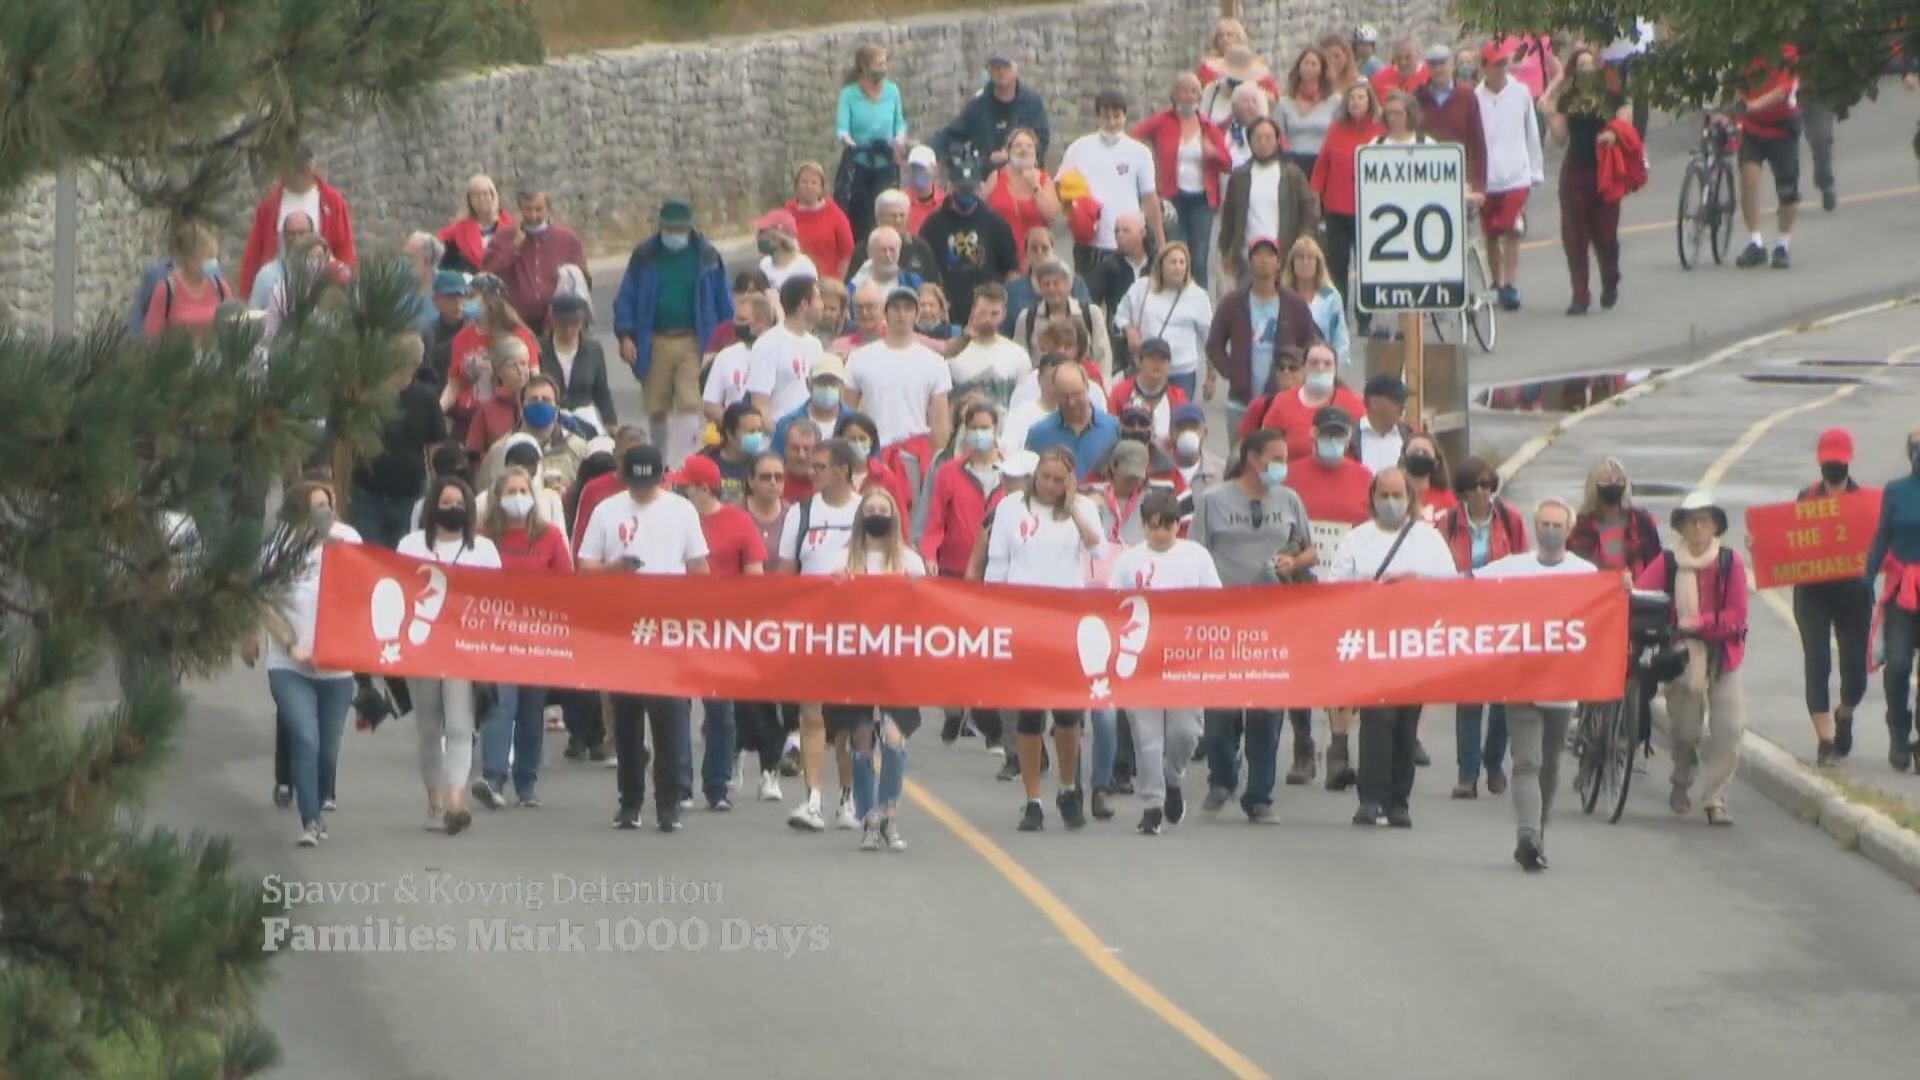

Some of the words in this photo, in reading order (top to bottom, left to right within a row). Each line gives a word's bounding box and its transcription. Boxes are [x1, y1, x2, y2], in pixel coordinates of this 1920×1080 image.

[1364, 161, 1457, 183] MAXIMUM
[1369, 203, 1453, 263] 20
[1375, 284, 1450, 305] km/h
[1795, 497, 1840, 520] FREE
[1786, 527, 1820, 549] THE
[1835, 523, 1847, 543] 2
[1773, 553, 1867, 579] MICHAELS
[522, 606, 568, 621] steps
[461, 614, 486, 629] for
[494, 615, 570, 638] freedom
[490, 643, 505, 653] for
[508, 644, 526, 656] the
[632, 618, 1013, 659] #BRINGTHEMHOME
[1237, 629, 1268, 648] pas
[1336, 619, 1588, 662] #LIBÉREZLES
[1163, 647, 1202, 664] pour
[1209, 644, 1225, 660] la
[1231, 644, 1289, 660] liberté
